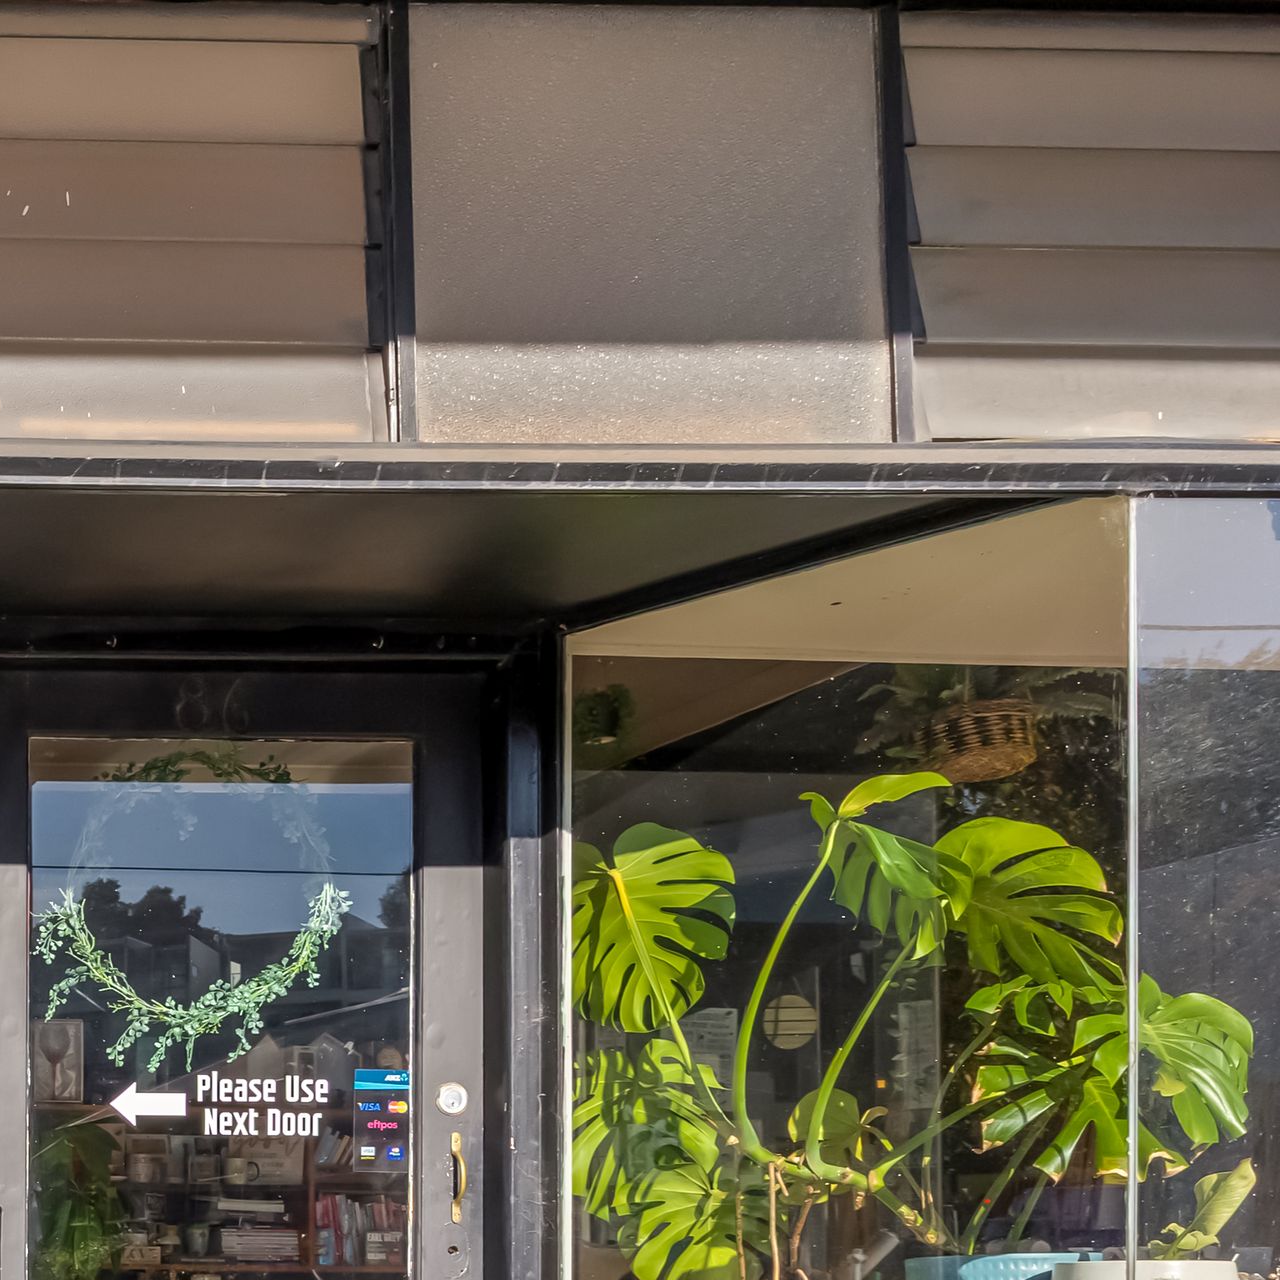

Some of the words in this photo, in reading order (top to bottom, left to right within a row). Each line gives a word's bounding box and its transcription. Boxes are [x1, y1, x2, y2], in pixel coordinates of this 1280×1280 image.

[196, 1071, 276, 1103] Please
[285, 1074, 329, 1103] Use
[356, 1102, 381, 1111] VISA
[203, 1107, 259, 1136] Next
[266, 1108, 323, 1137] Door
[367, 1119, 398, 1131] eftpos
